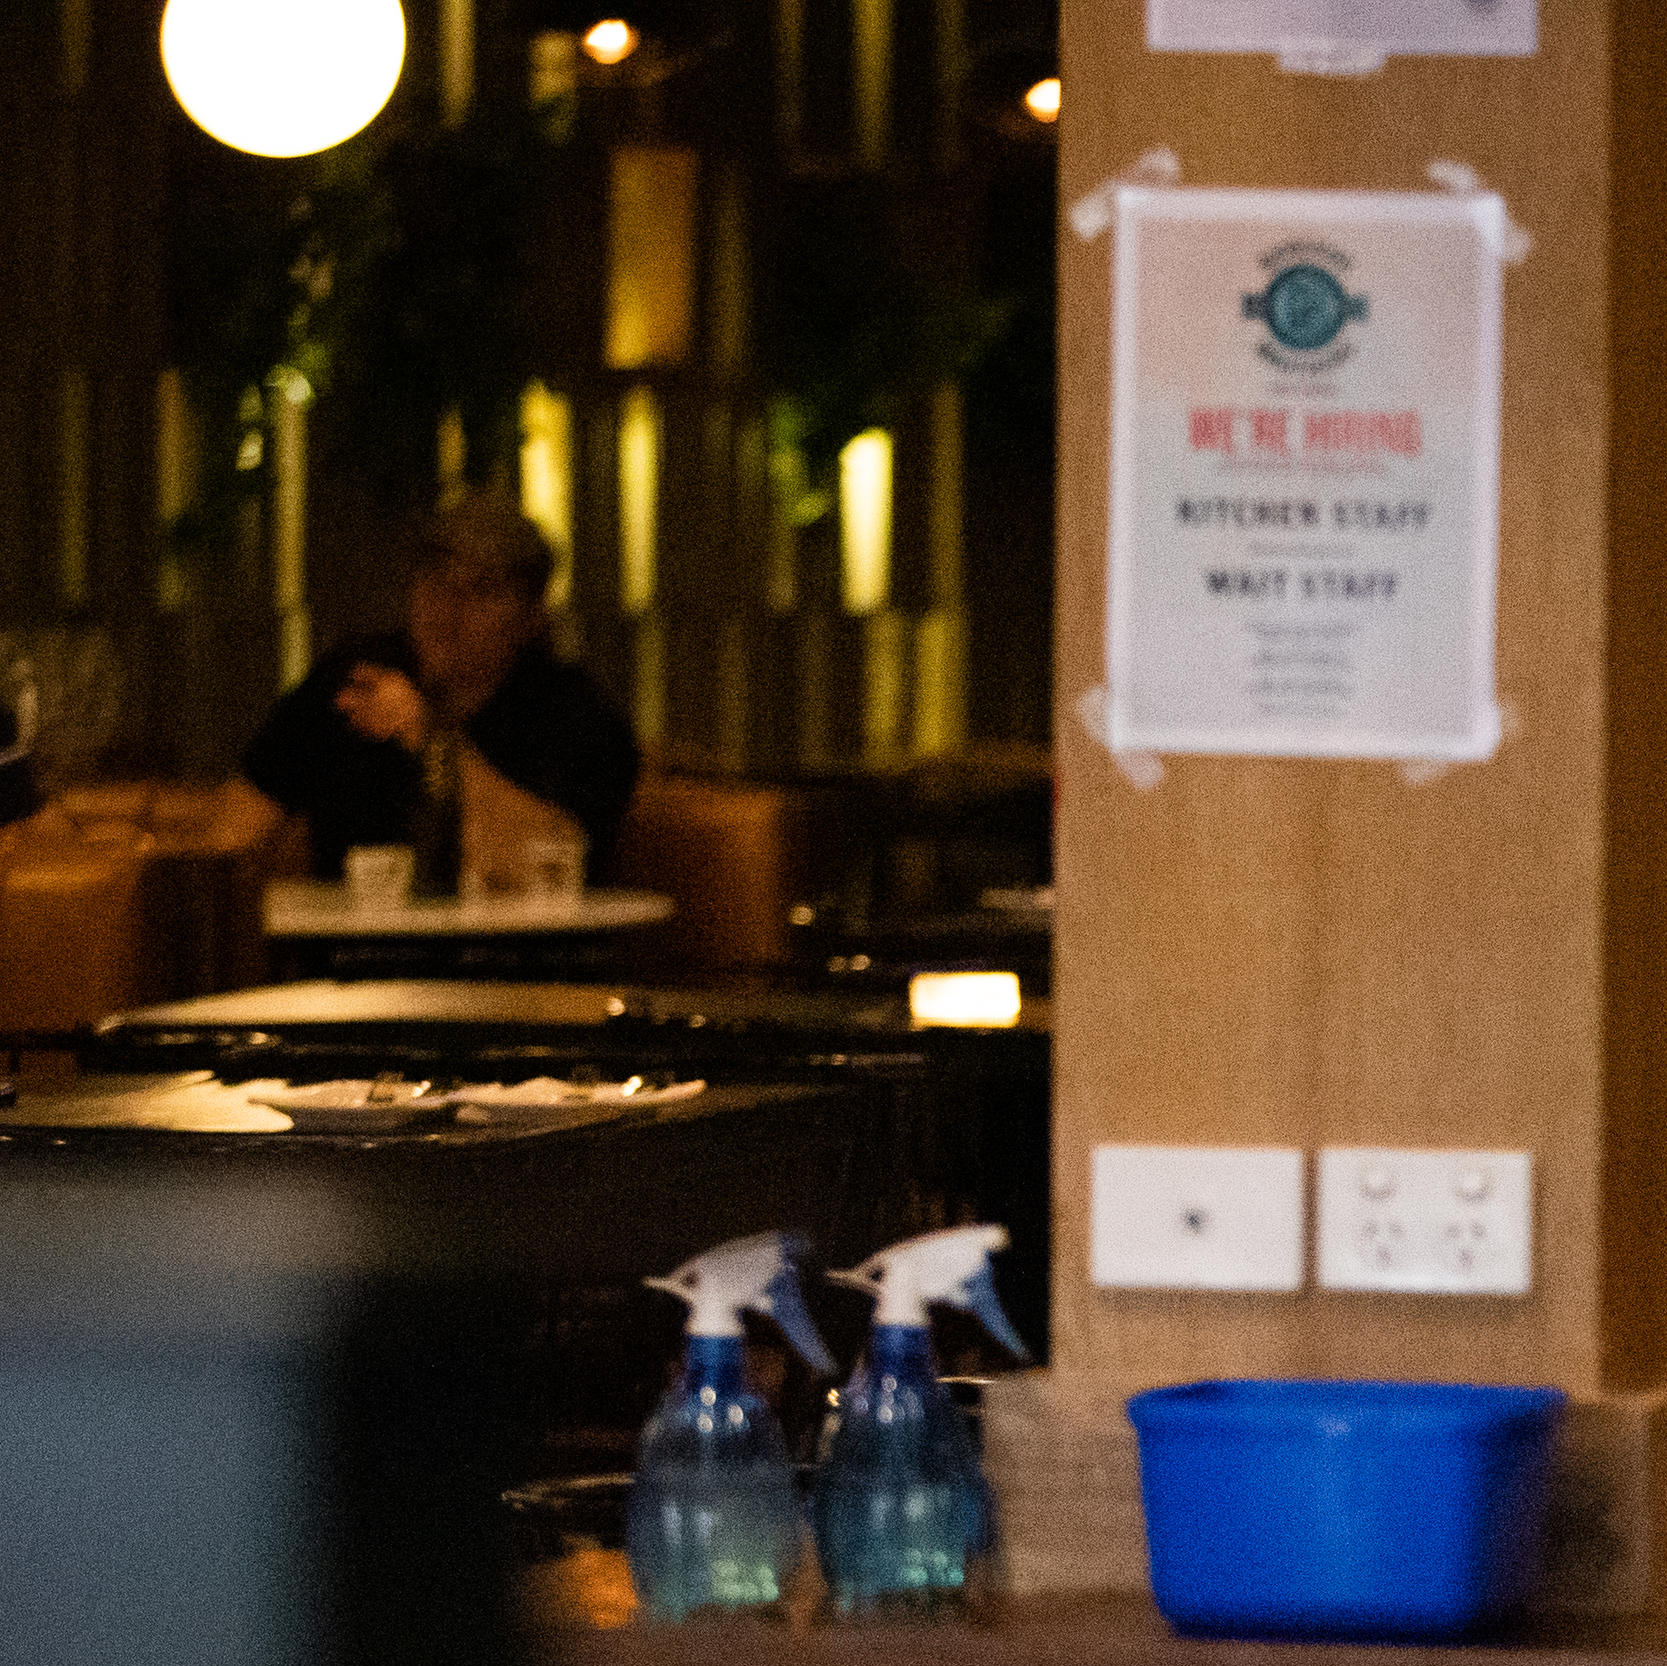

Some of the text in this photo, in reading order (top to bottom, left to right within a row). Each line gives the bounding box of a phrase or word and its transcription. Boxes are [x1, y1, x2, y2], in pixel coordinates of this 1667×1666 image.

[1304, 412, 1422, 457] HIRING
[1175, 500, 1430, 529] KITCHEN STAFF
[1207, 571, 1397, 599] WAIT STAFF
